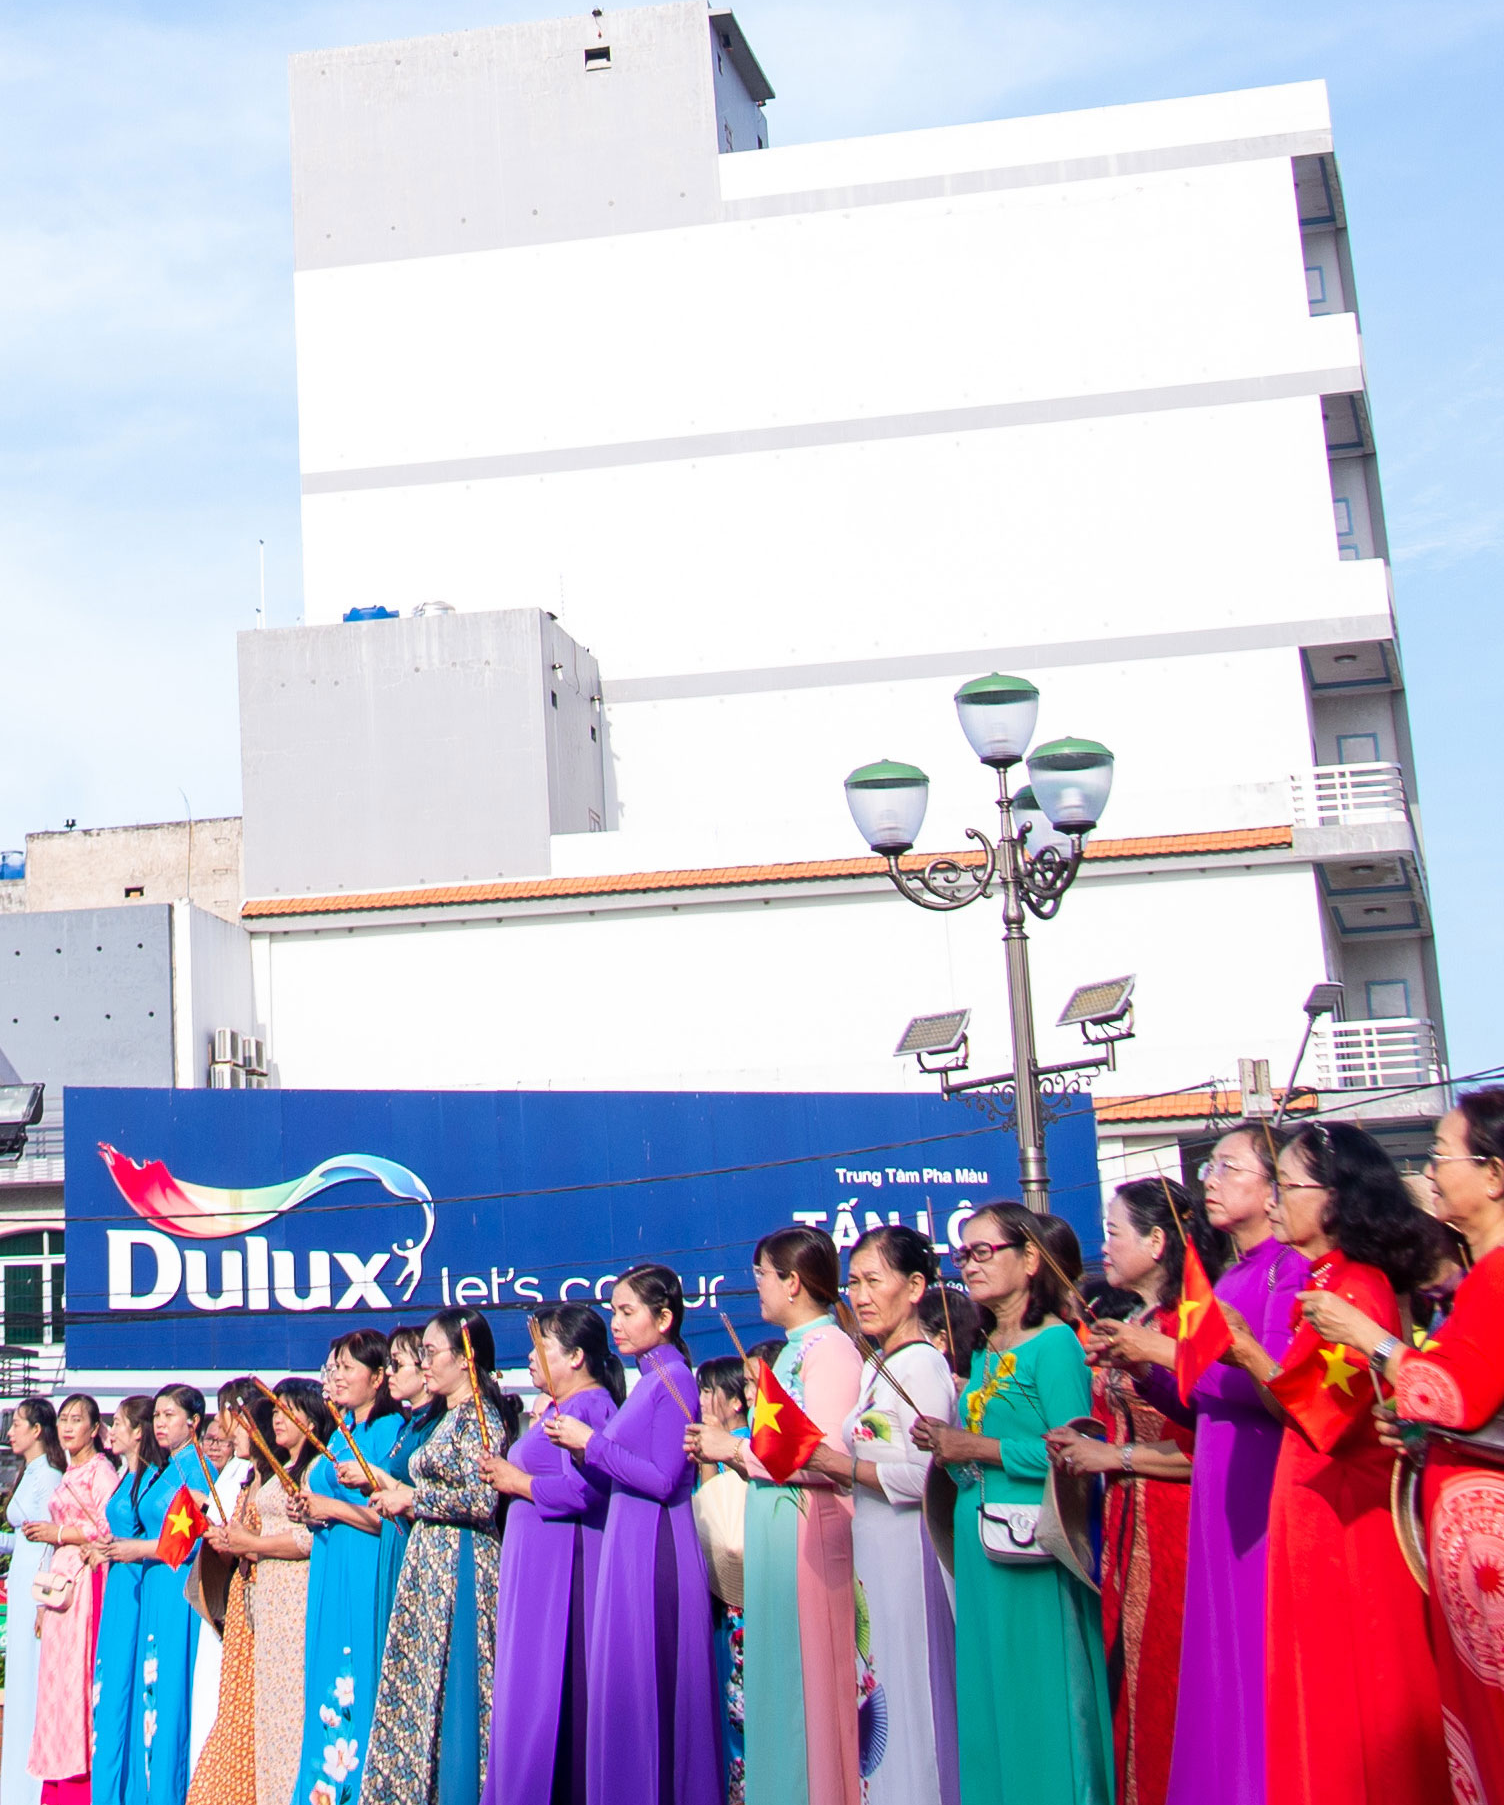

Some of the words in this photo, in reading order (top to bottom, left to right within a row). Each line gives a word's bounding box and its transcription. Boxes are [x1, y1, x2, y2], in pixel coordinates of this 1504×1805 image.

[835, 1168, 882, 1187] Trung
[885, 1168, 920, 1184] Tâm
[922, 1168, 952, 1184] Pha
[955, 1168, 988, 1184] Màu
[106, 1229, 393, 1311] Dulux
